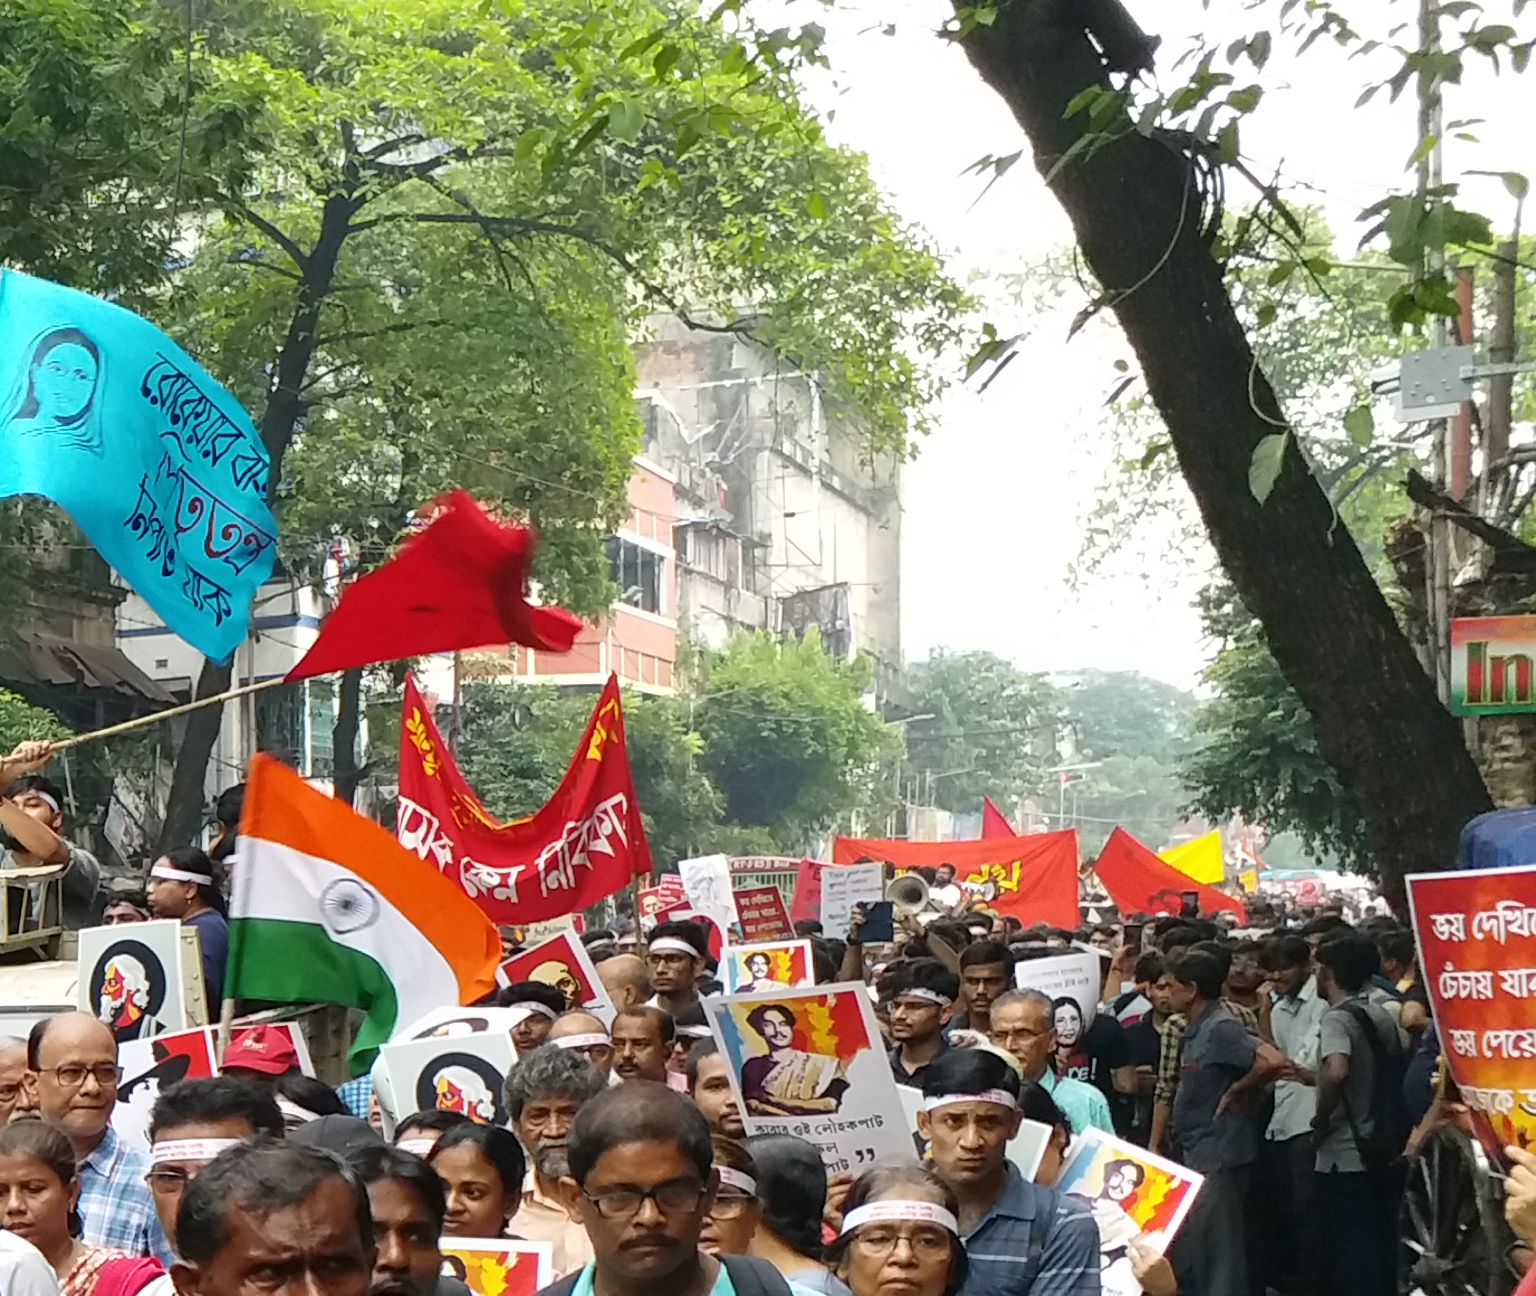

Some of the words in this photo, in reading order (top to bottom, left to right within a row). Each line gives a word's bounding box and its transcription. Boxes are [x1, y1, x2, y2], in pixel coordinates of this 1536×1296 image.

[1430, 914, 1465, 942] ভয়
[1439, 961, 1493, 1000] চেঁচায়
[1449, 1029, 1477, 1057] ভয়
